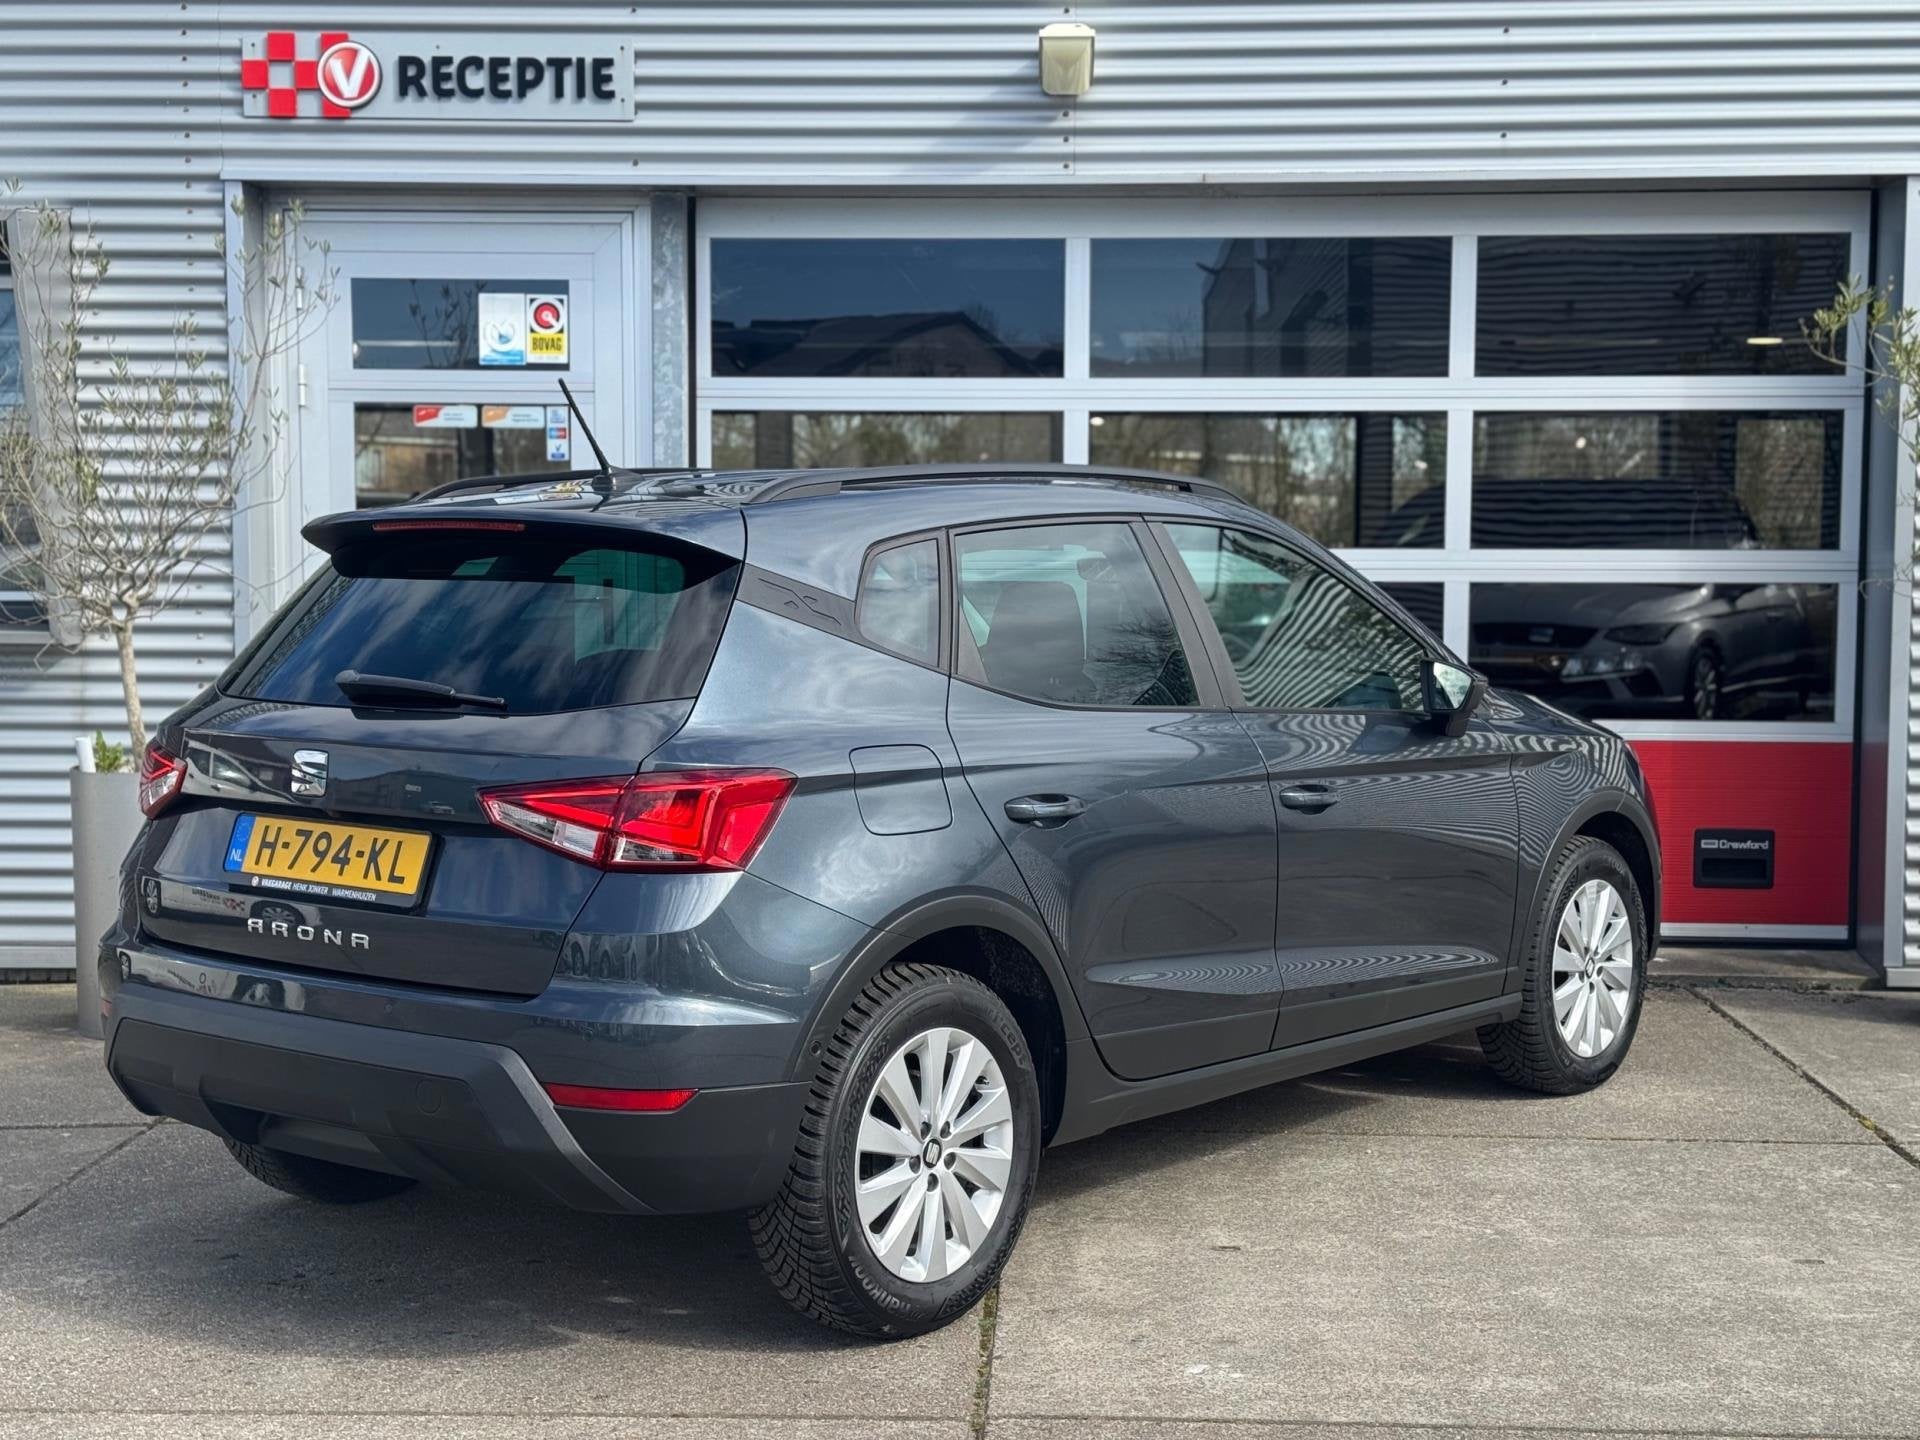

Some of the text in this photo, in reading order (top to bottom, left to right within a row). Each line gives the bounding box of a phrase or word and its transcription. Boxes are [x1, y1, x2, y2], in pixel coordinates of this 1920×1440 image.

[397, 55, 616, 99] RECEPTIE
[532, 337, 562, 352] BOVAG
[230, 825, 405, 885] NL H-794-KL
[1718, 839, 1769, 850] Crawford
[261, 878, 377, 902] VAKGARAGE HENK JONKER WARMENHUIZEN
[247, 917, 370, 949] ARONA
